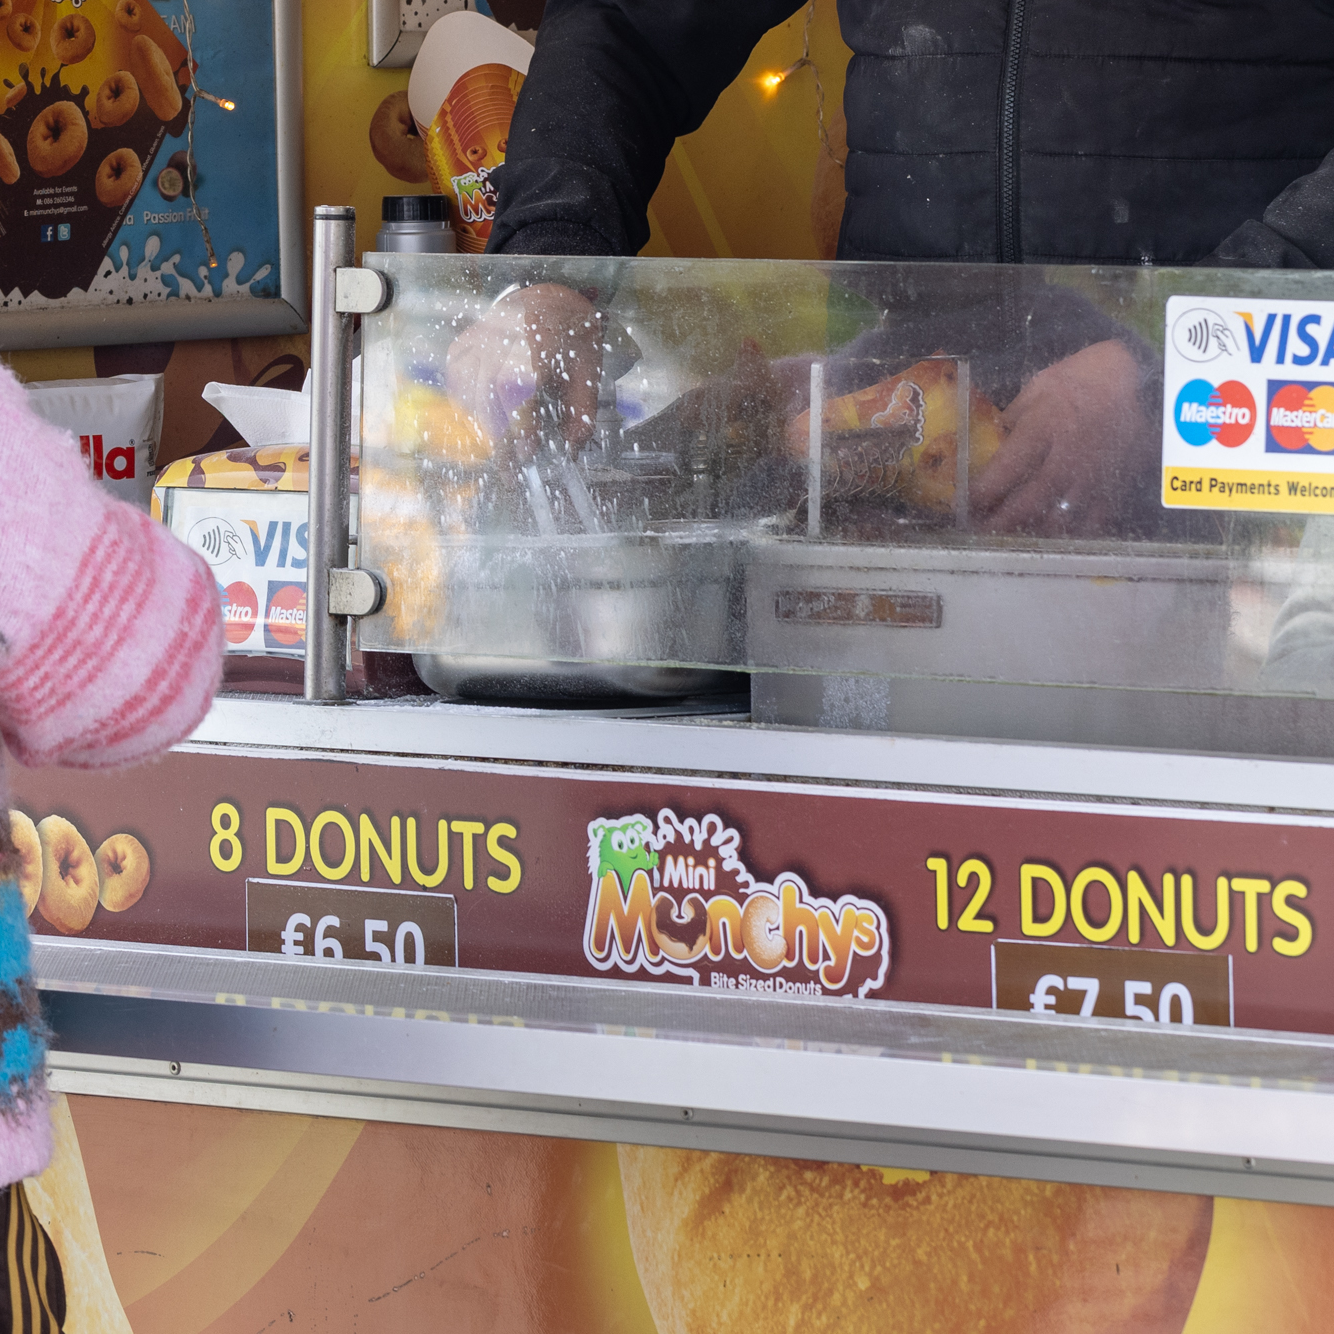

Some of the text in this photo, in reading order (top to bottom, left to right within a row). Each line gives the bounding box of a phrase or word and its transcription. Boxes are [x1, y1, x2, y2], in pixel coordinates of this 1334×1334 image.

[143, 209, 185, 226] Passion
[1179, 401, 1251, 425] Maestro
[79, 433, 136, 481] lla
[1170, 476, 1203, 493] Card
[1208, 477, 1281, 498] Payments
[240, 519, 308, 568] VIS
[268, 606, 307, 625] Master
[209, 802, 522, 894] 8 DONUTS
[663, 854, 716, 891] Mini
[926, 857, 1314, 958] 12 DONUTS
[710, 971, 823, 996] Bite Sized Donuts
